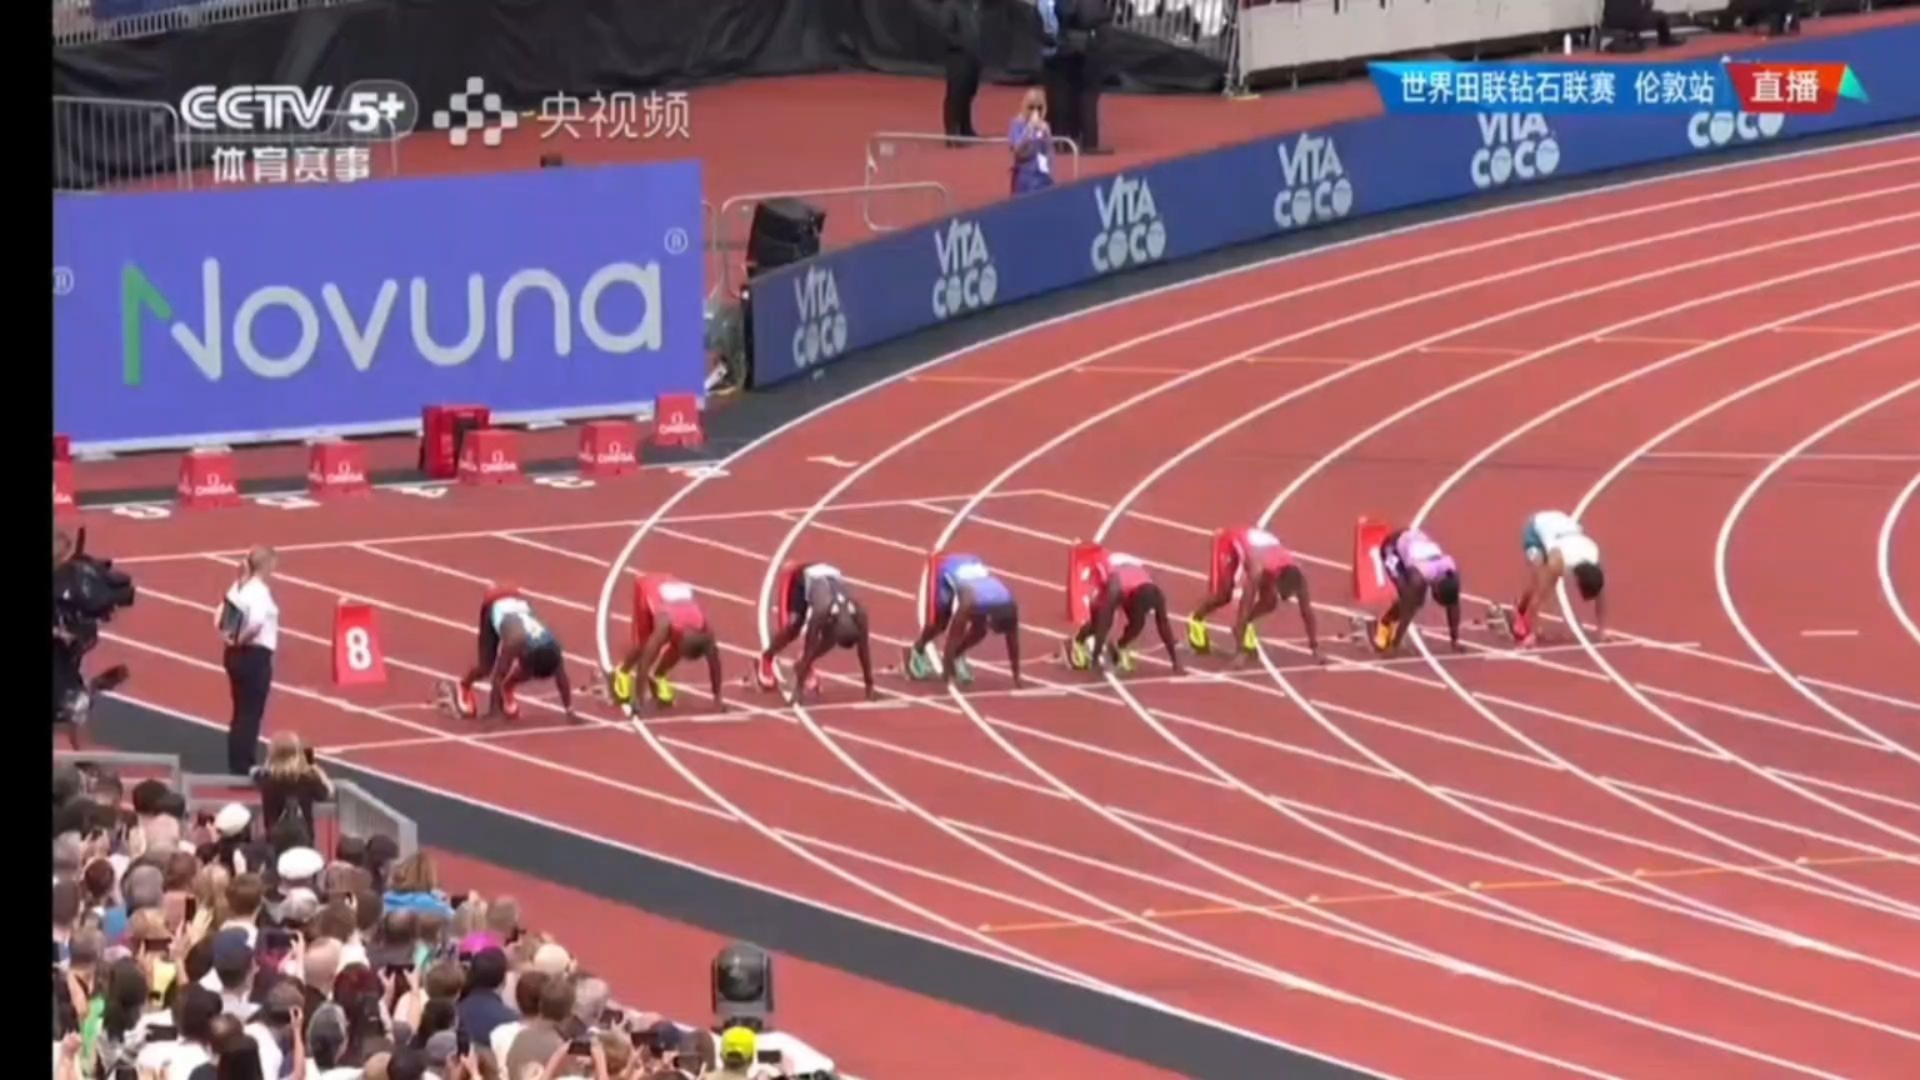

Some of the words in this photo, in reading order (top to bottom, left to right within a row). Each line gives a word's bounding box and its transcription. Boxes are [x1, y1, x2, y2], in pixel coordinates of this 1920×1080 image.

[1278, 132, 1343, 187] VITA
[1471, 138, 1560, 188] COCO
[1094, 173, 1157, 230] VITA
[1273, 178, 1353, 228] COCO
[934, 218, 989, 276] VITA
[1091, 220, 1166, 273] COCO
[794, 264, 840, 323] VITA
[932, 264, 997, 320] COCO
[120, 257, 664, 387] Novuna
[792, 312, 847, 369] COCO
[345, 626, 373, 671] 8
